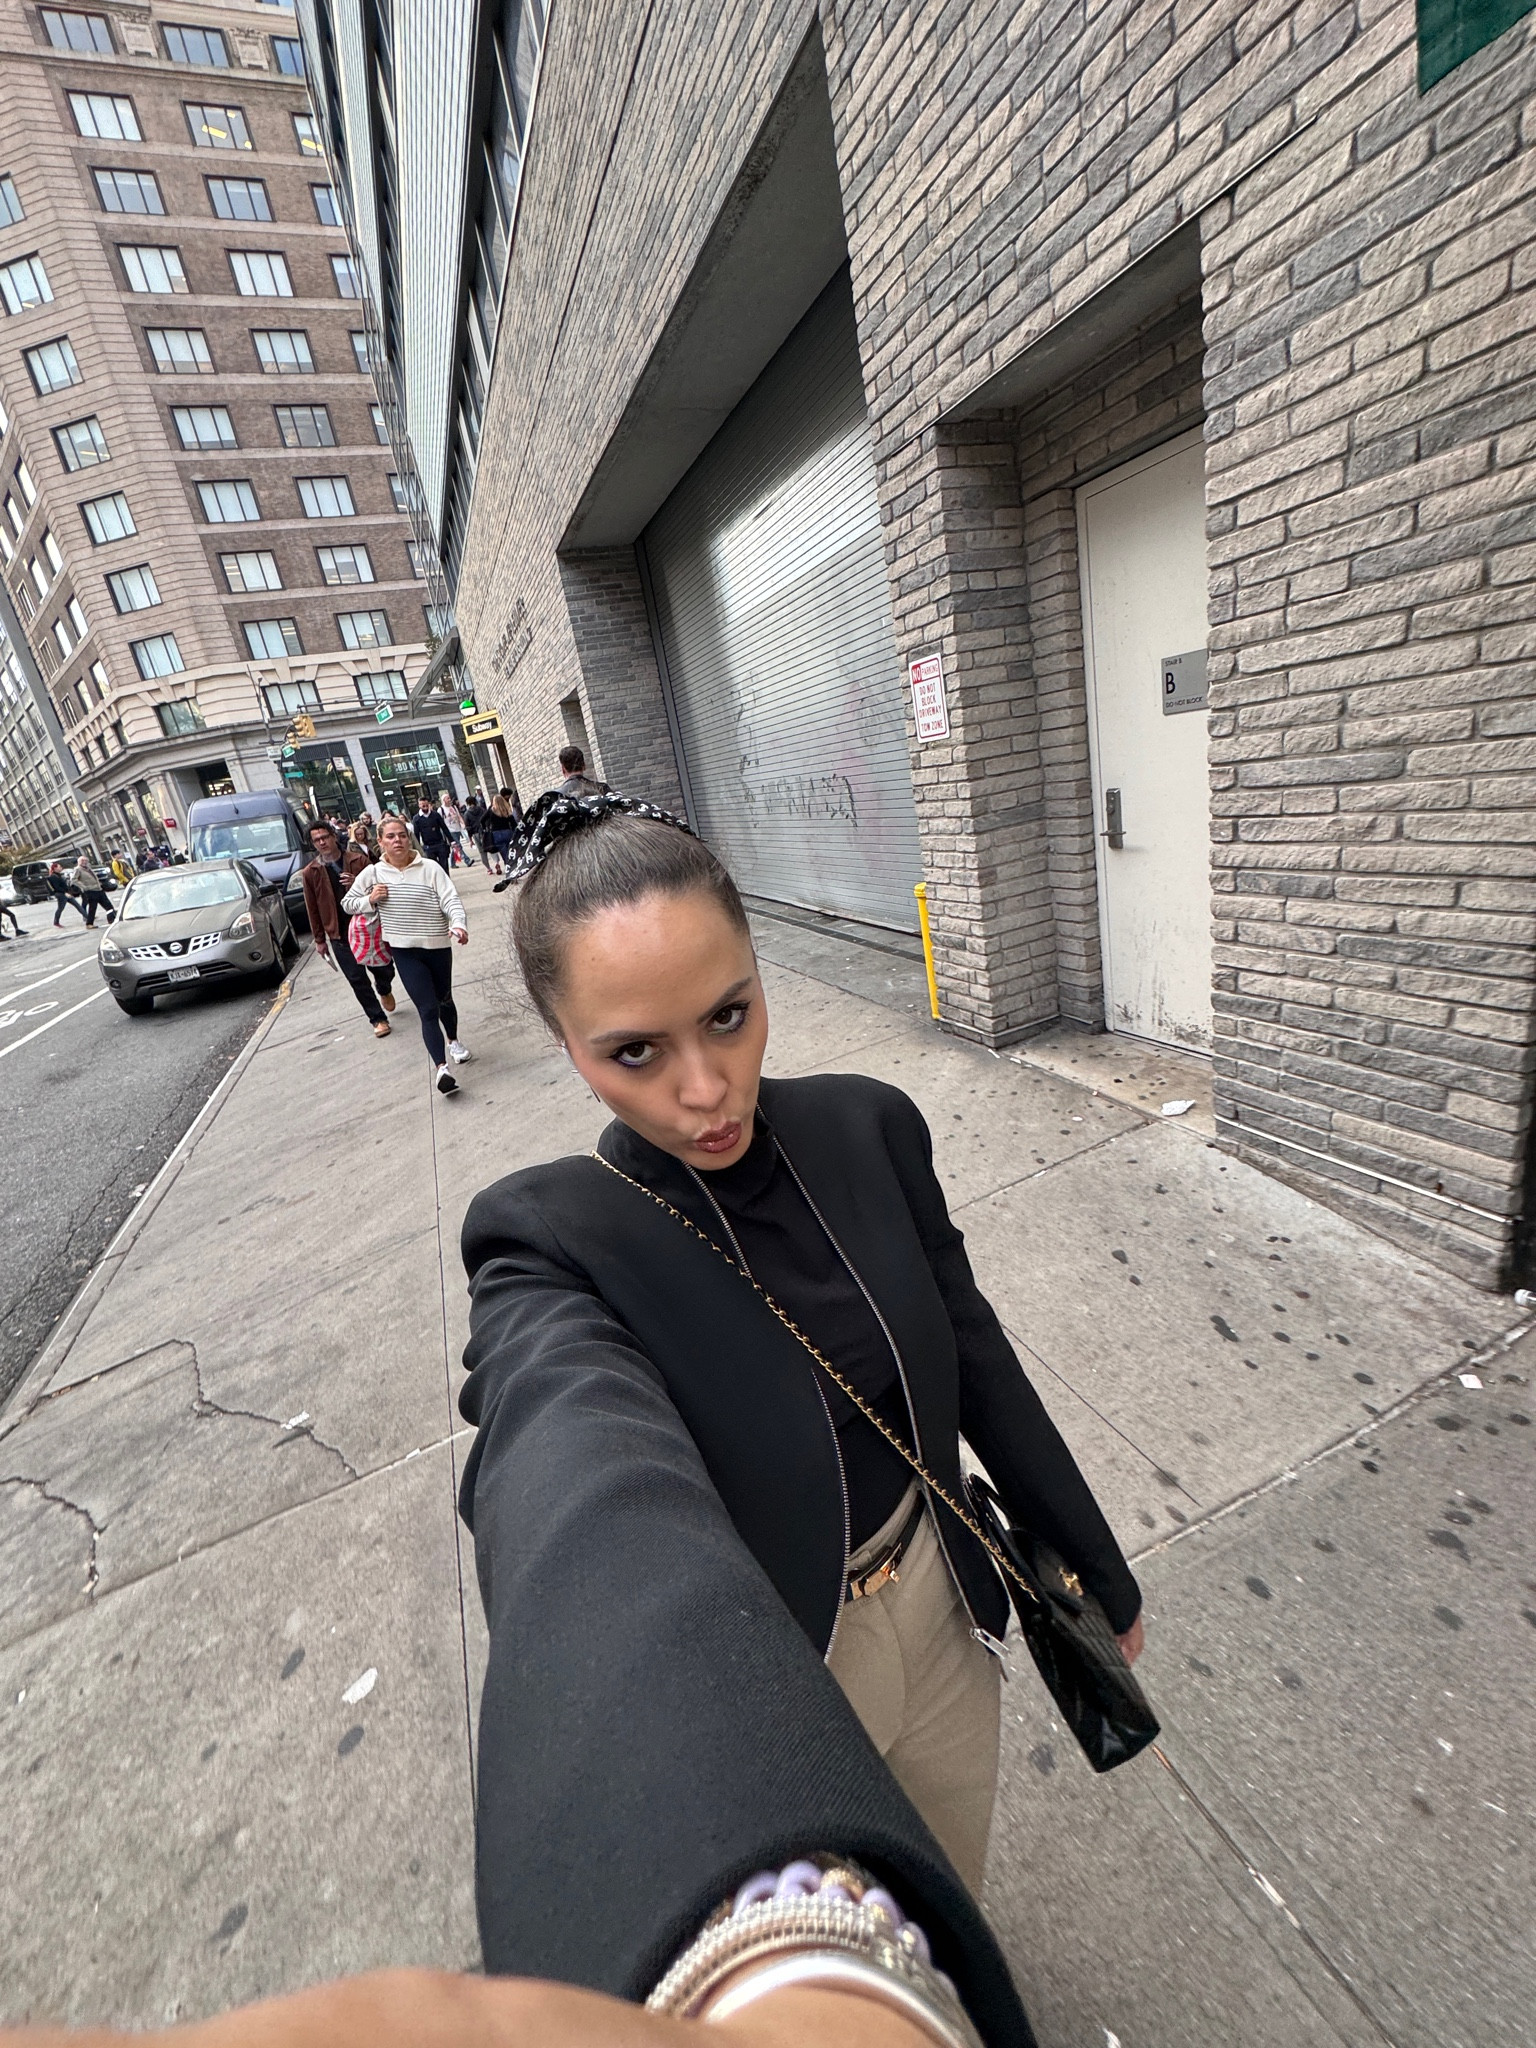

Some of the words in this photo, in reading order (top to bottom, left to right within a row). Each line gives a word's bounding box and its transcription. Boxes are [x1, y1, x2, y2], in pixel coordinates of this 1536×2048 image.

[912, 667, 921, 682] NO
[920, 685, 926, 695] DO
[927, 683, 936, 693] NOT
[1165, 672, 1176, 694] B
[922, 695, 936, 706] BLOCK
[1186, 696, 1203, 705] BLOCK
[919, 706, 942, 718] DRIVEWAY
[471, 721, 493, 733] Subway
[920, 723, 931, 732] TOW
[931, 719, 943, 730] ZONE
[408, 758, 438, 769] KATOM
